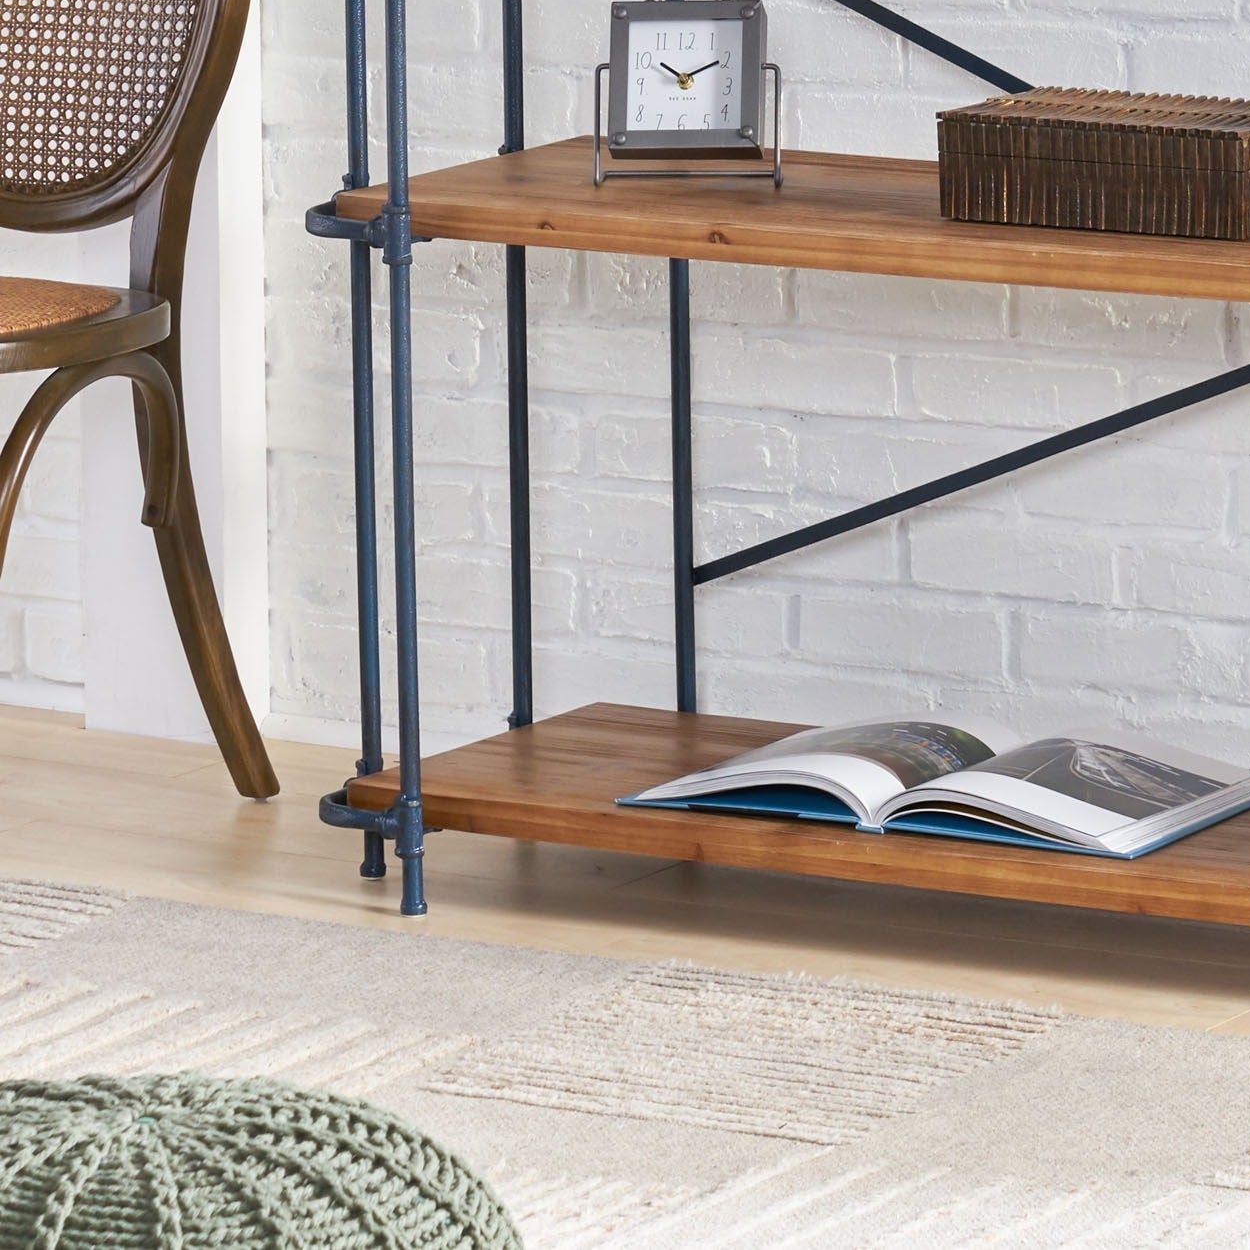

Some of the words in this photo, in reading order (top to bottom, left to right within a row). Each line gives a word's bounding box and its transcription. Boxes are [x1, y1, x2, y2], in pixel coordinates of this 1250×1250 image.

[656, 32, 667, 50] 11
[678, 32, 696, 51] 12
[635, 51, 652, 70] 10
[677, 113, 688, 130] 6
